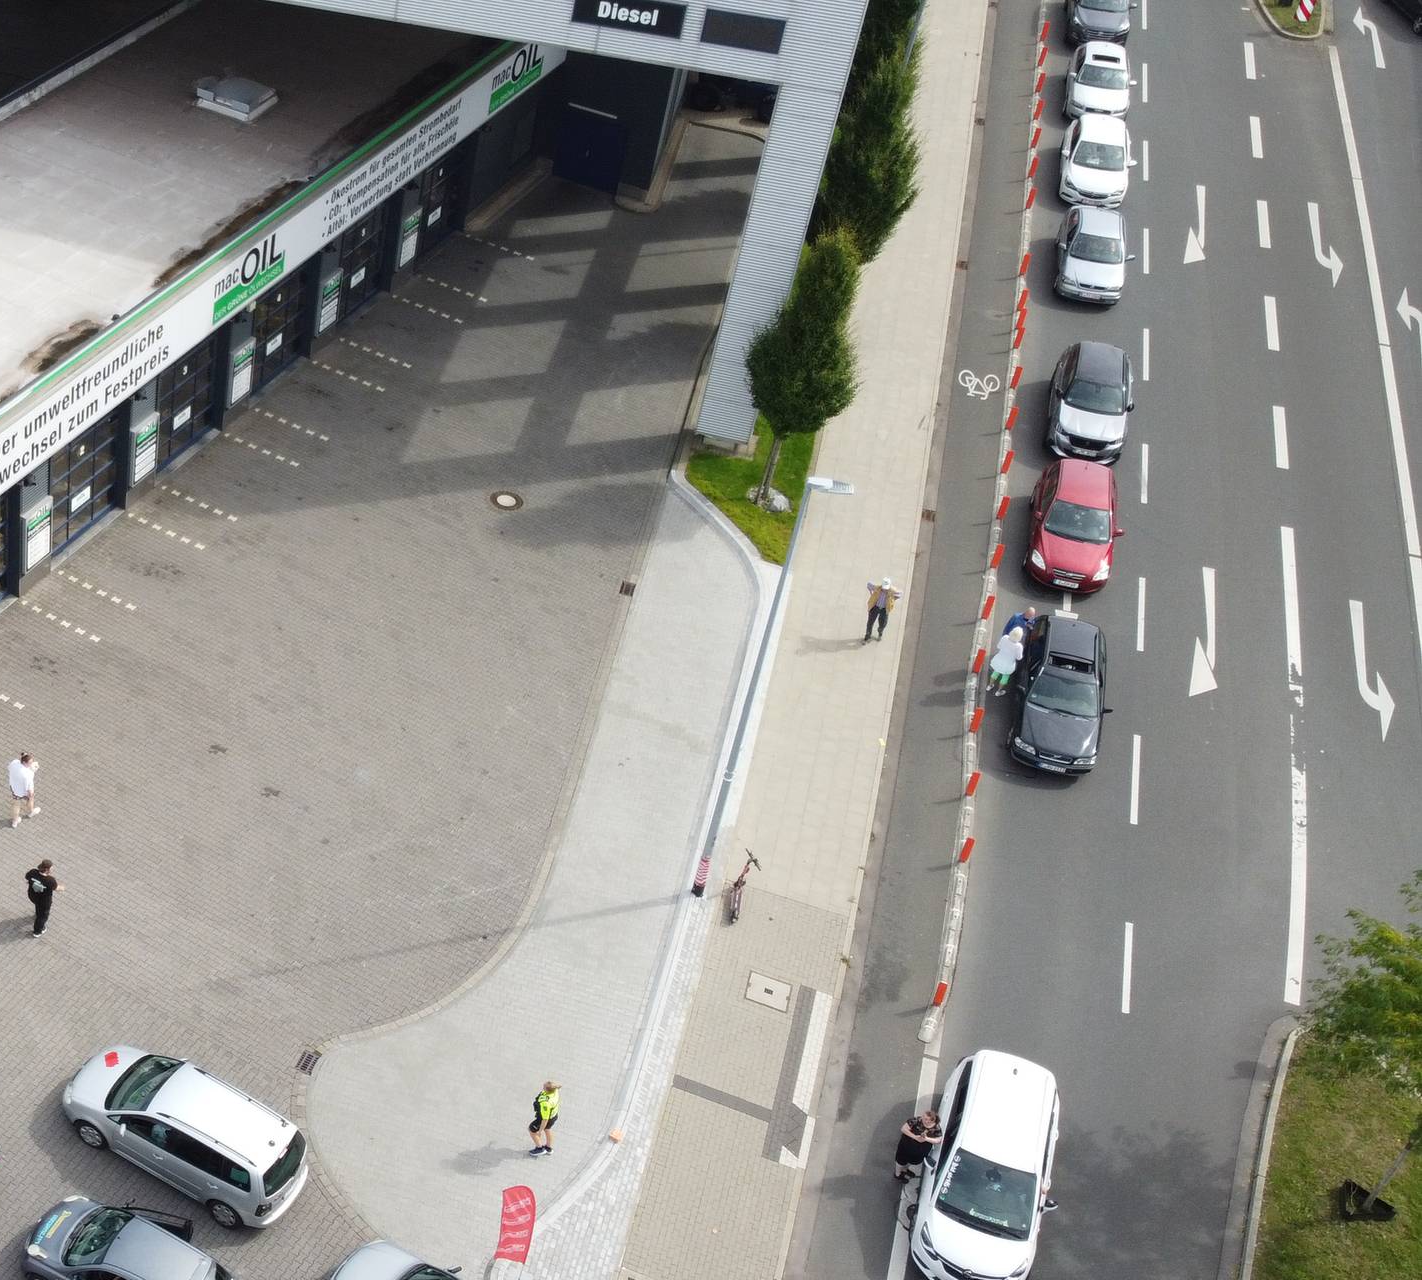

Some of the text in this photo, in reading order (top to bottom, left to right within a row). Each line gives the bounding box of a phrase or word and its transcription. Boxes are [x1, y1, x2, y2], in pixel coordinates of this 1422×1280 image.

[597, 1, 659, 26] Diesel
[330, 98, 462, 203] Ökostrom für gesamten Strombedarf
[350, 182, 393, 219] Verwertung
[395, 166, 412, 185] statt
[414, 132, 457, 171] Verbrennung
[401, 150, 411, 167] für
[413, 142, 426, 157] alle
[428, 116, 459, 147] Frischöle
[24, 324, 164, 440] umweltfreundliche
[68, 400, 99, 432] zum
[104, 345, 169, 405] Festpreis
